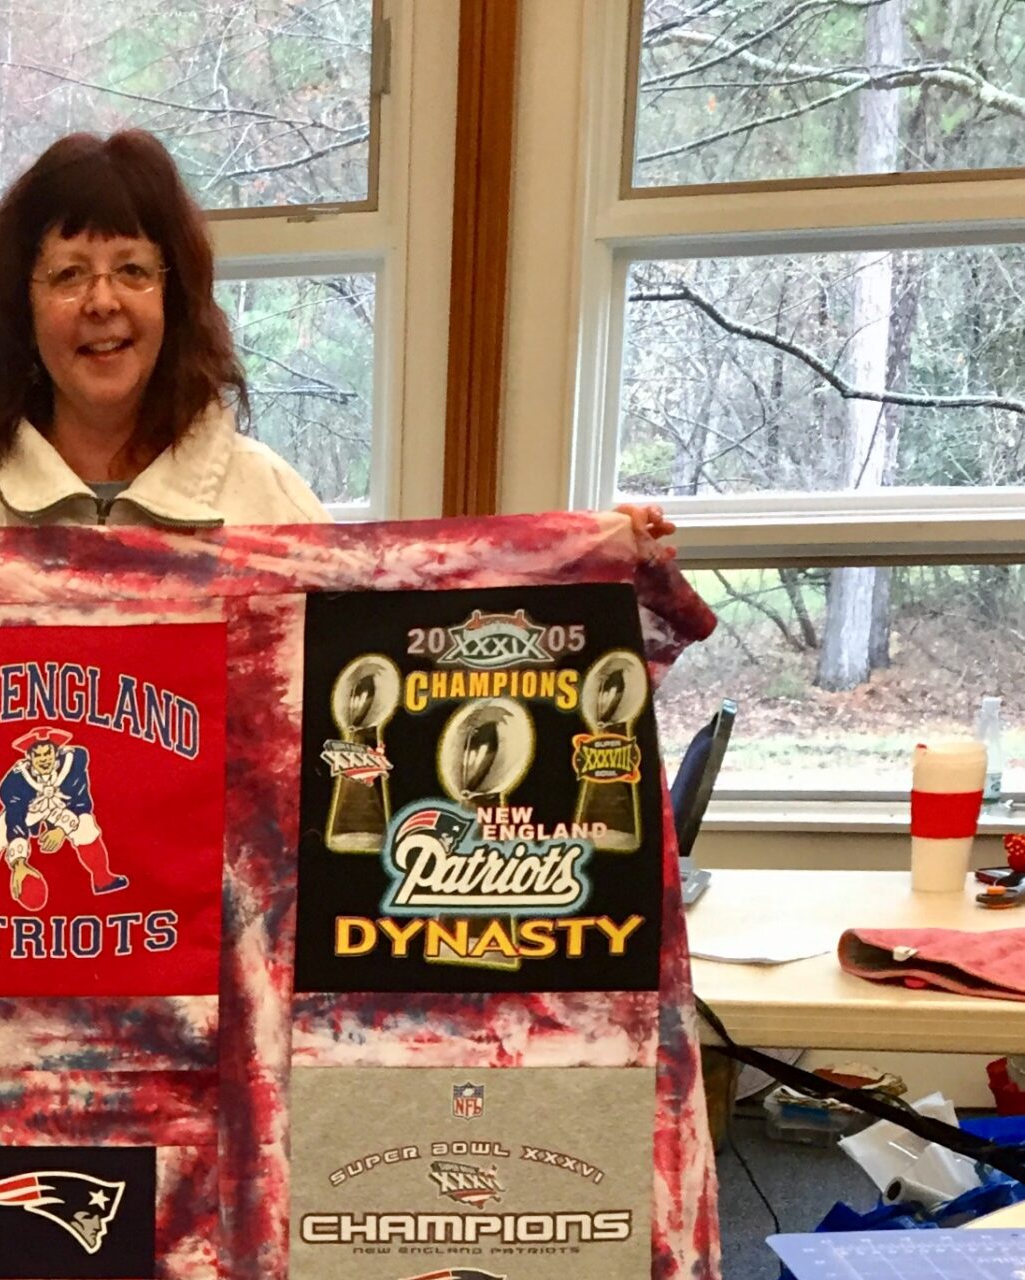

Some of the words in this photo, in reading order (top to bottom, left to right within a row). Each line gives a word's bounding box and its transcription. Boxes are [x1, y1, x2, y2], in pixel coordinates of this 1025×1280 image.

[0, 661, 200, 760] ENGLAND
[405, 669, 579, 711] CHAMPIONS
[477, 808, 533, 824] NEW
[483, 823, 607, 841] ENGLAND
[393, 835, 585, 907] Patriots
[335, 915, 645, 958] DYNASTY
[454, 1098, 482, 1116] NFL
[329, 1145, 421, 1187] SUPER
[431, 1141, 510, 1157] BOWL
[521, 1145, 605, 1184] XXXVI
[300, 1210, 633, 1244] CHAMPIONS
